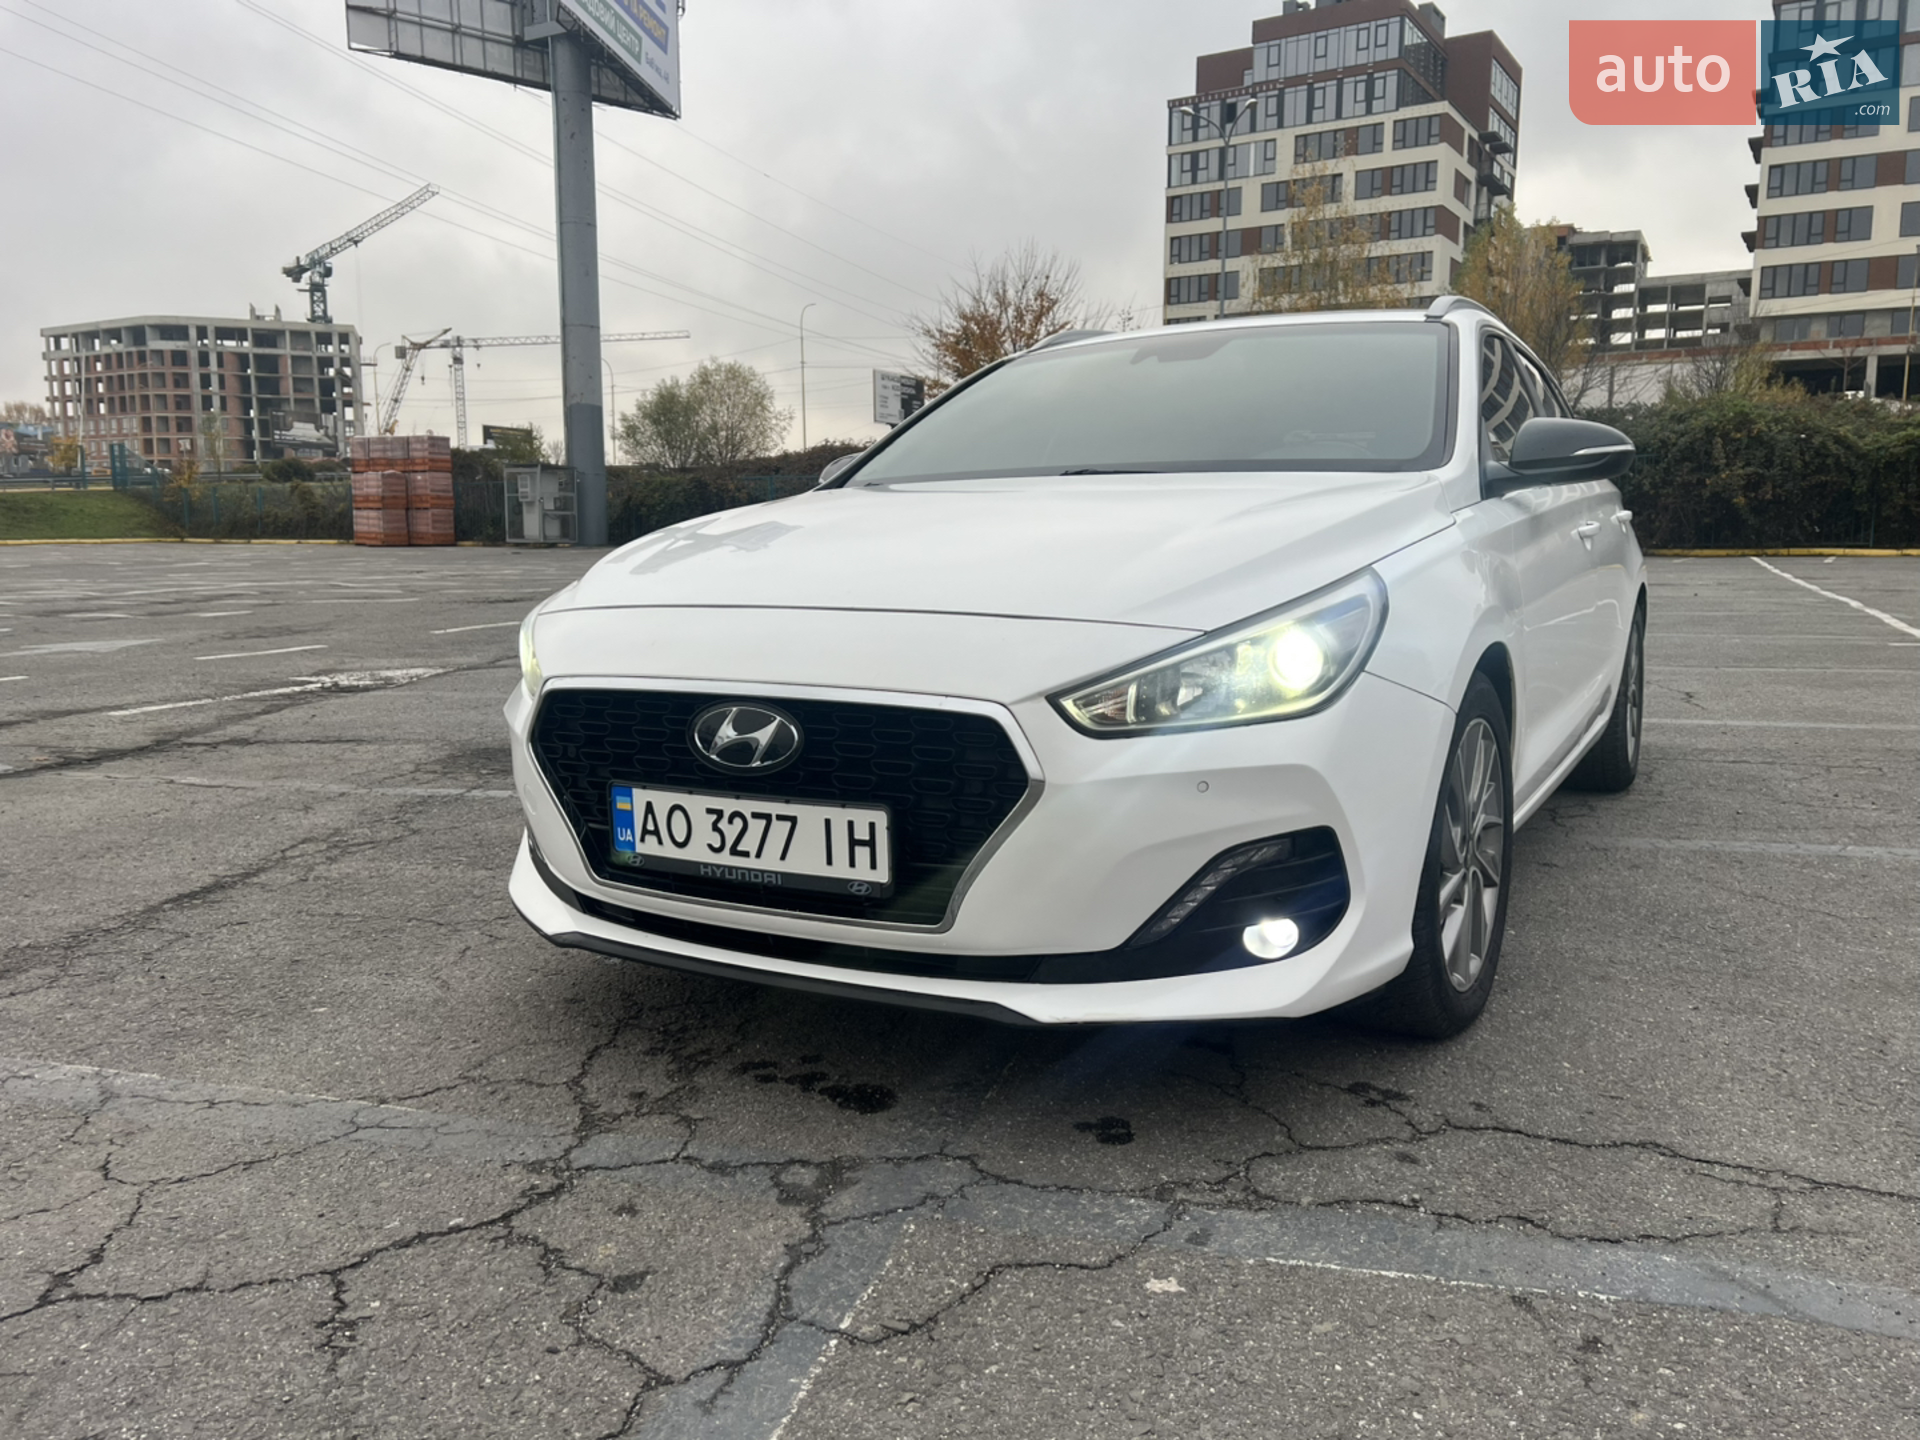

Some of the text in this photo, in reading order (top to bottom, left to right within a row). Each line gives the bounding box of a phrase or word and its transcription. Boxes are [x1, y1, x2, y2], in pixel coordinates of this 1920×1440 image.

[582, 0, 616, 34] ДОВИЙ
[617, 827, 634, 842] UA
[639, 800, 878, 870] AO 3277 IH
[700, 864, 782, 886] HYUNDAI
